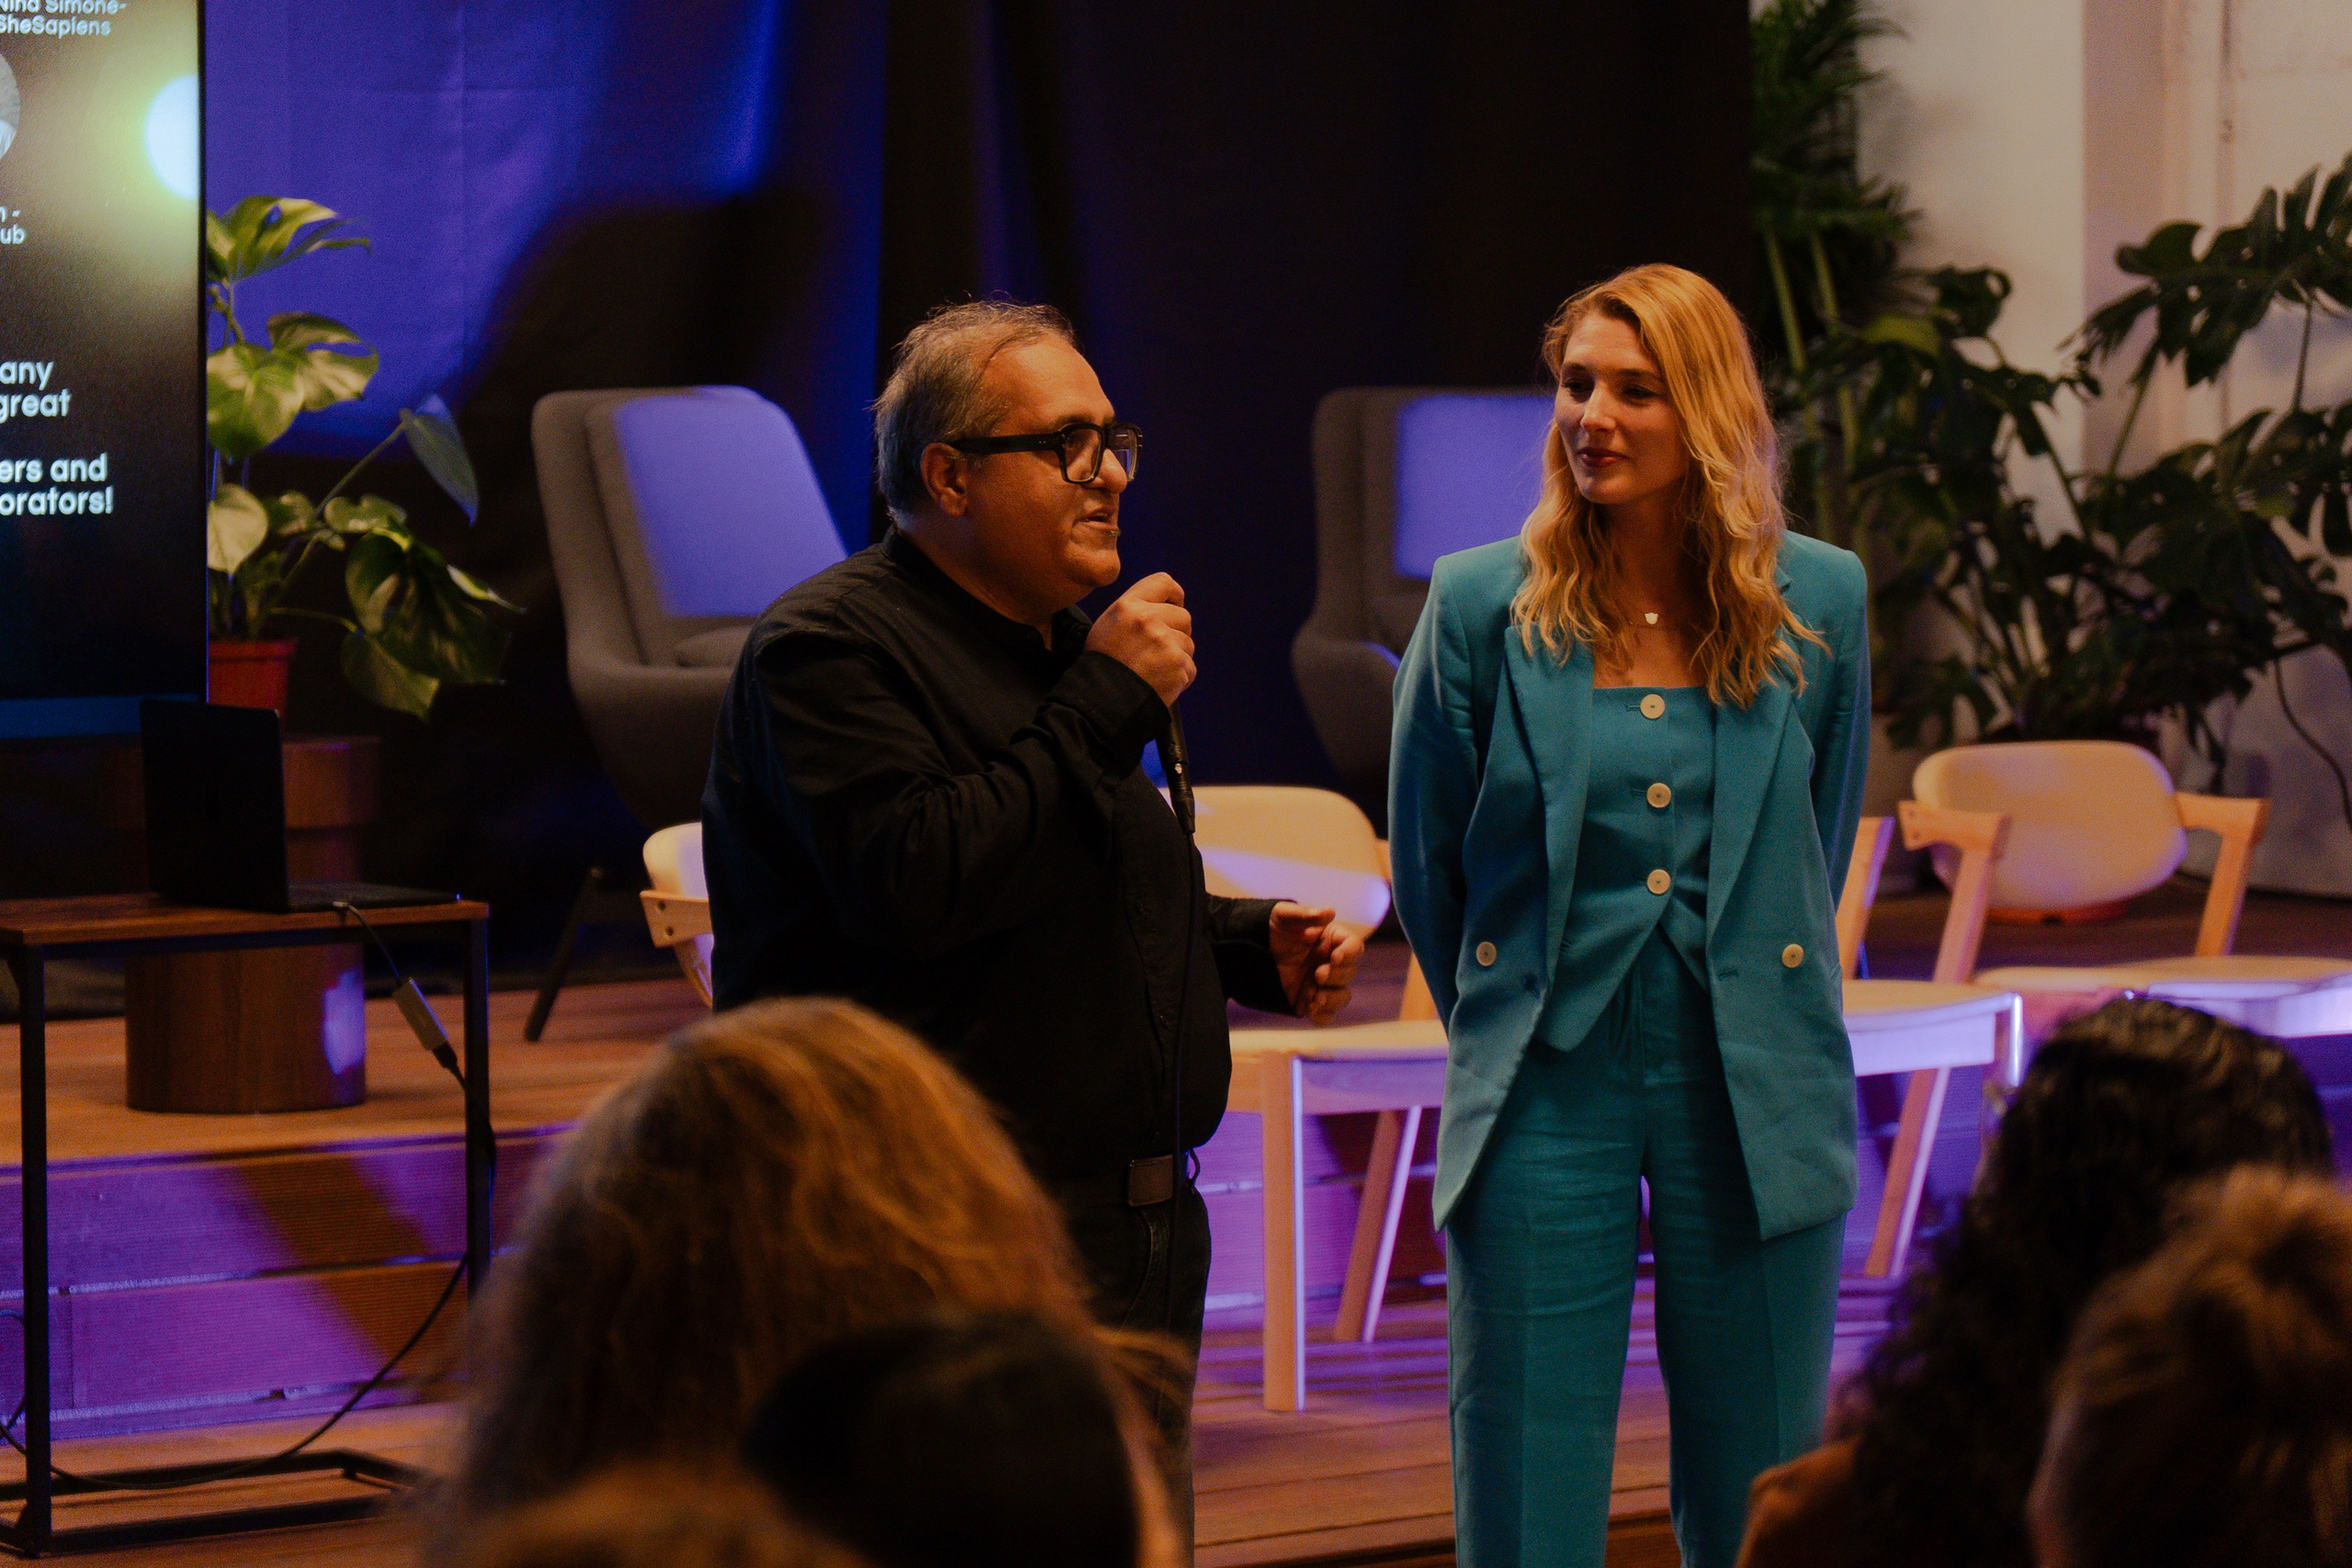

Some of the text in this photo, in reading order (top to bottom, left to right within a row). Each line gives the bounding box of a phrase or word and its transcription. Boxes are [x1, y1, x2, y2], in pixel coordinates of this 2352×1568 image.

[0, 224, 25, 244] ub
[0, 361, 54, 390] any
[0, 452, 107, 483] ers and
[0, 486, 114, 515] orators!
